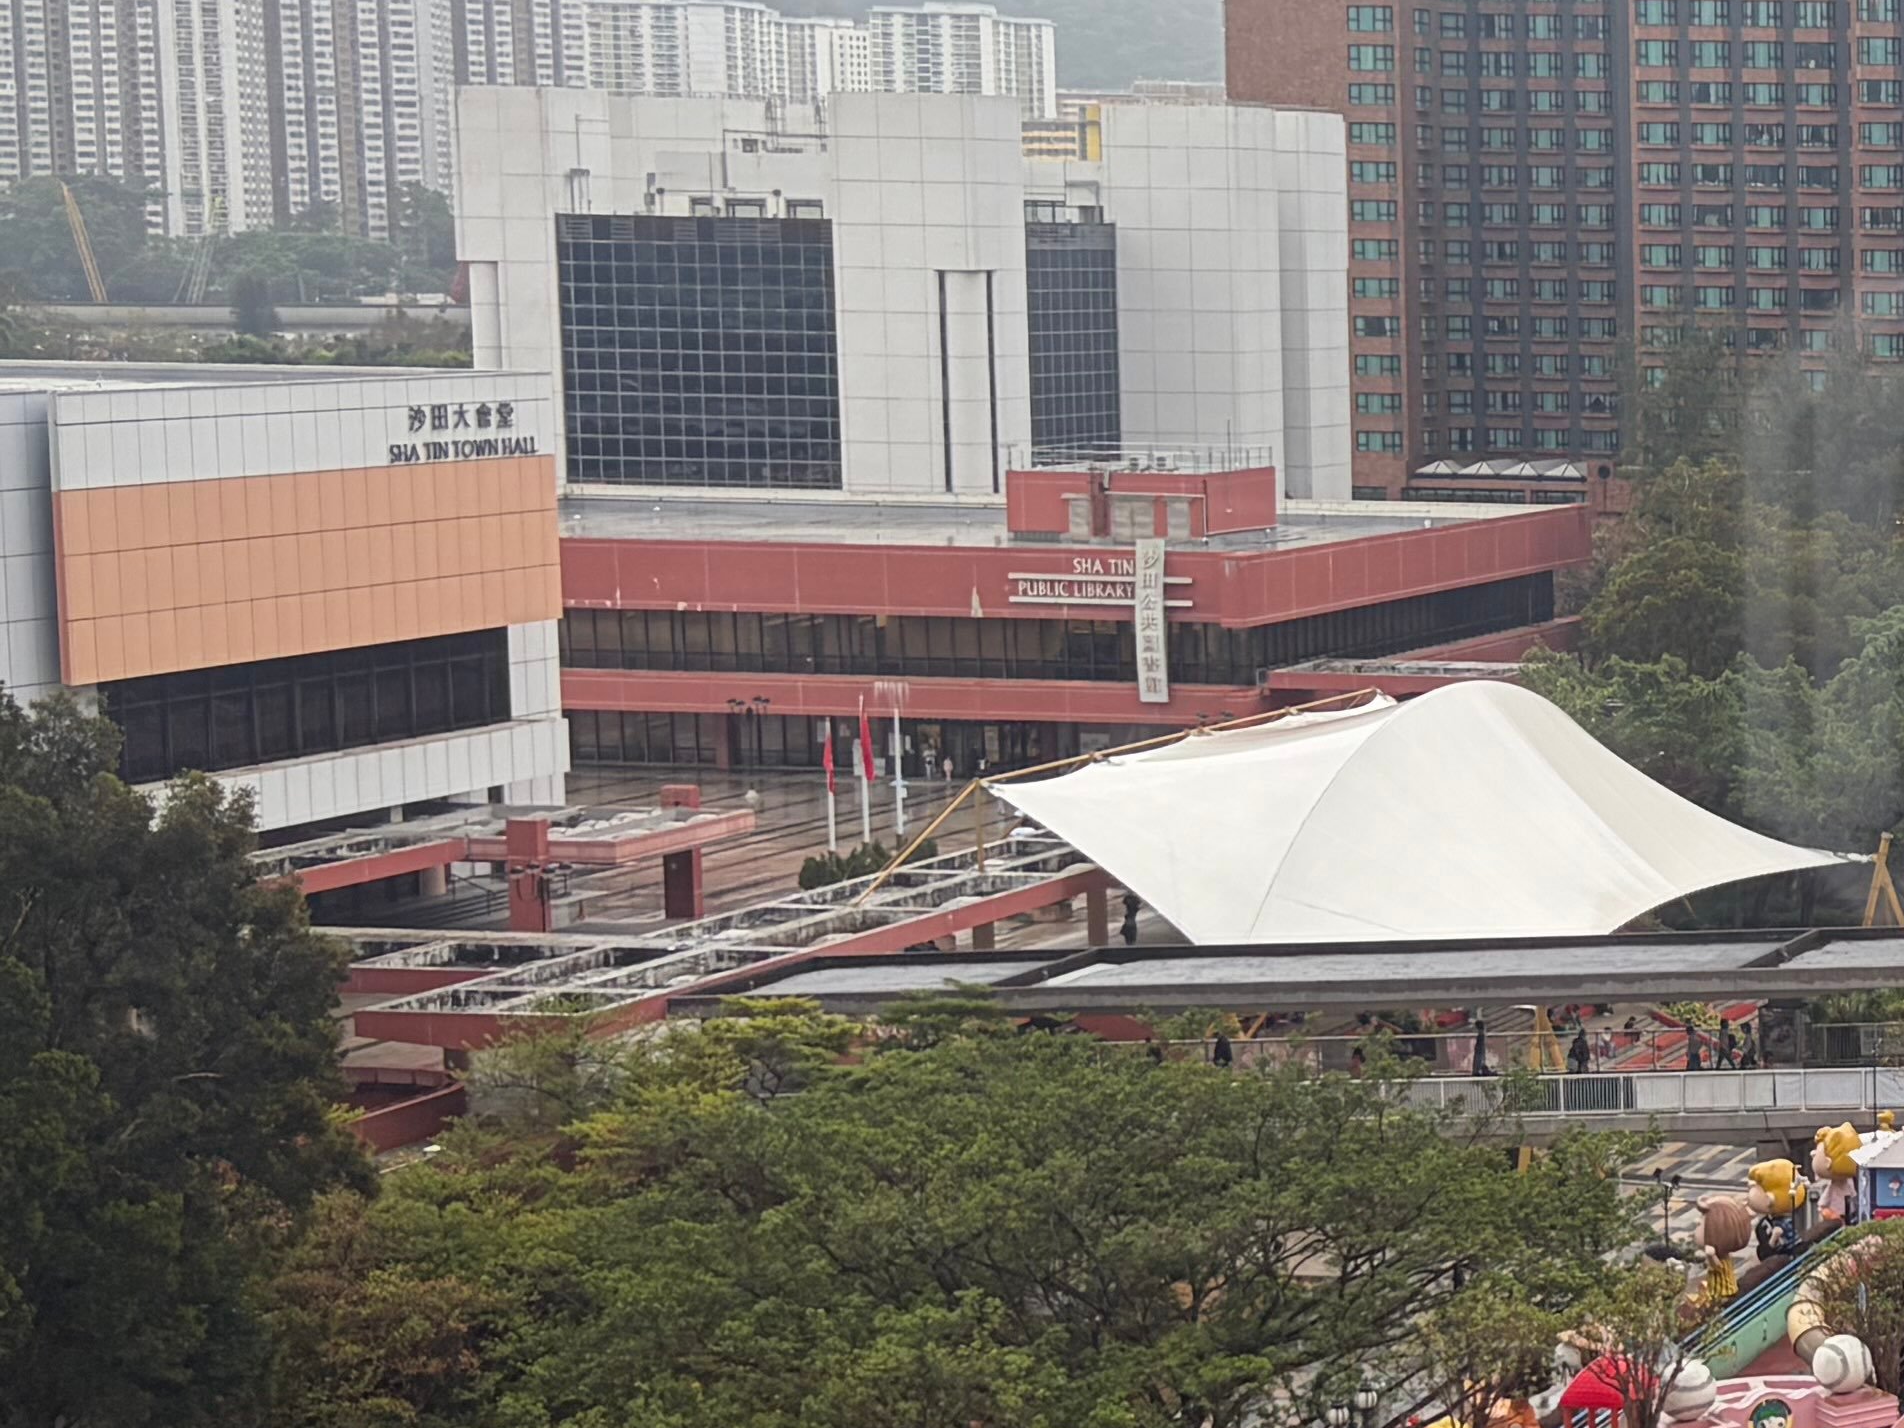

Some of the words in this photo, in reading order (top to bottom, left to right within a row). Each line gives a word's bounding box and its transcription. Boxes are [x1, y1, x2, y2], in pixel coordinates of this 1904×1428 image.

[407, 401, 515, 433] 沙田大會堂
[389, 443, 420, 464] SHA
[422, 441, 449, 461] TIN
[452, 438, 499, 459] TOWN
[501, 435, 539, 455] HALL
[1072, 557, 1104, 575] SHA
[1108, 558, 1135, 576] TIN
[1018, 580, 1070, 597] PUBLIC
[1073, 581, 1135, 599] LIBRARY
